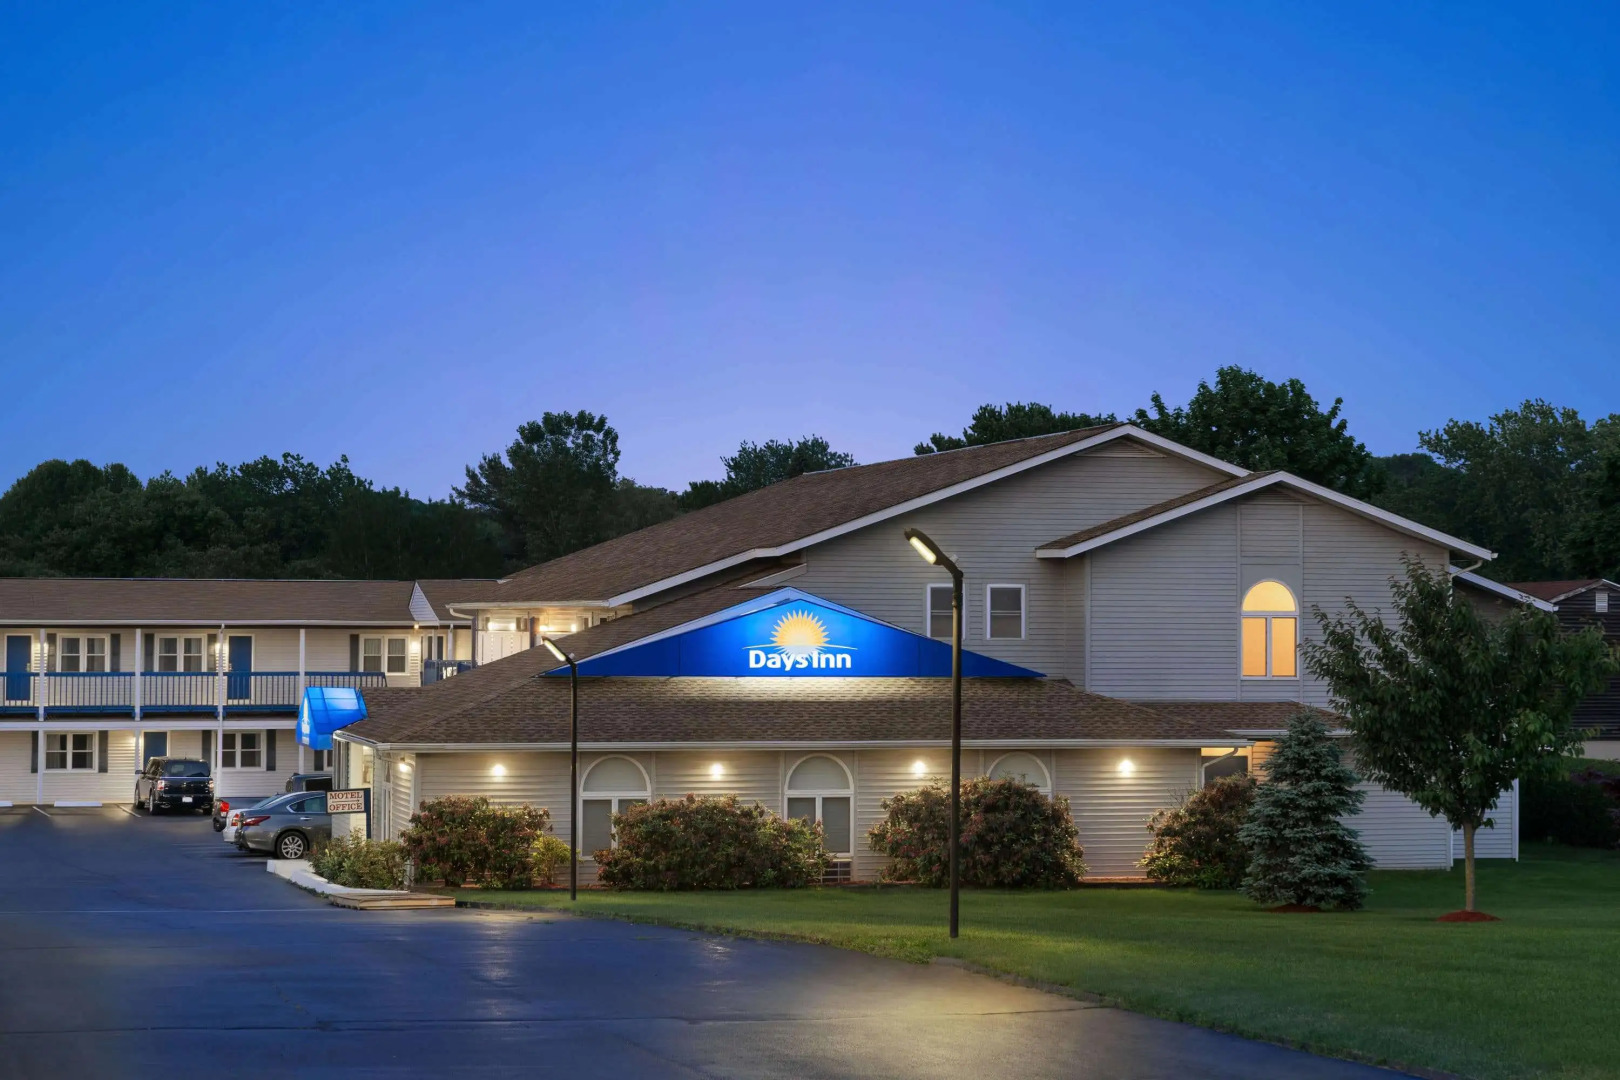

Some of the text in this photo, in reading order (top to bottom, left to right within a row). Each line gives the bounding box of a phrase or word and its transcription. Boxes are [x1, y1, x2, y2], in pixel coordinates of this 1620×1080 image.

[749, 650, 851, 671] Days Inn
[329, 791, 362, 800] MOTEL
[329, 802, 362, 811] OFFICE
